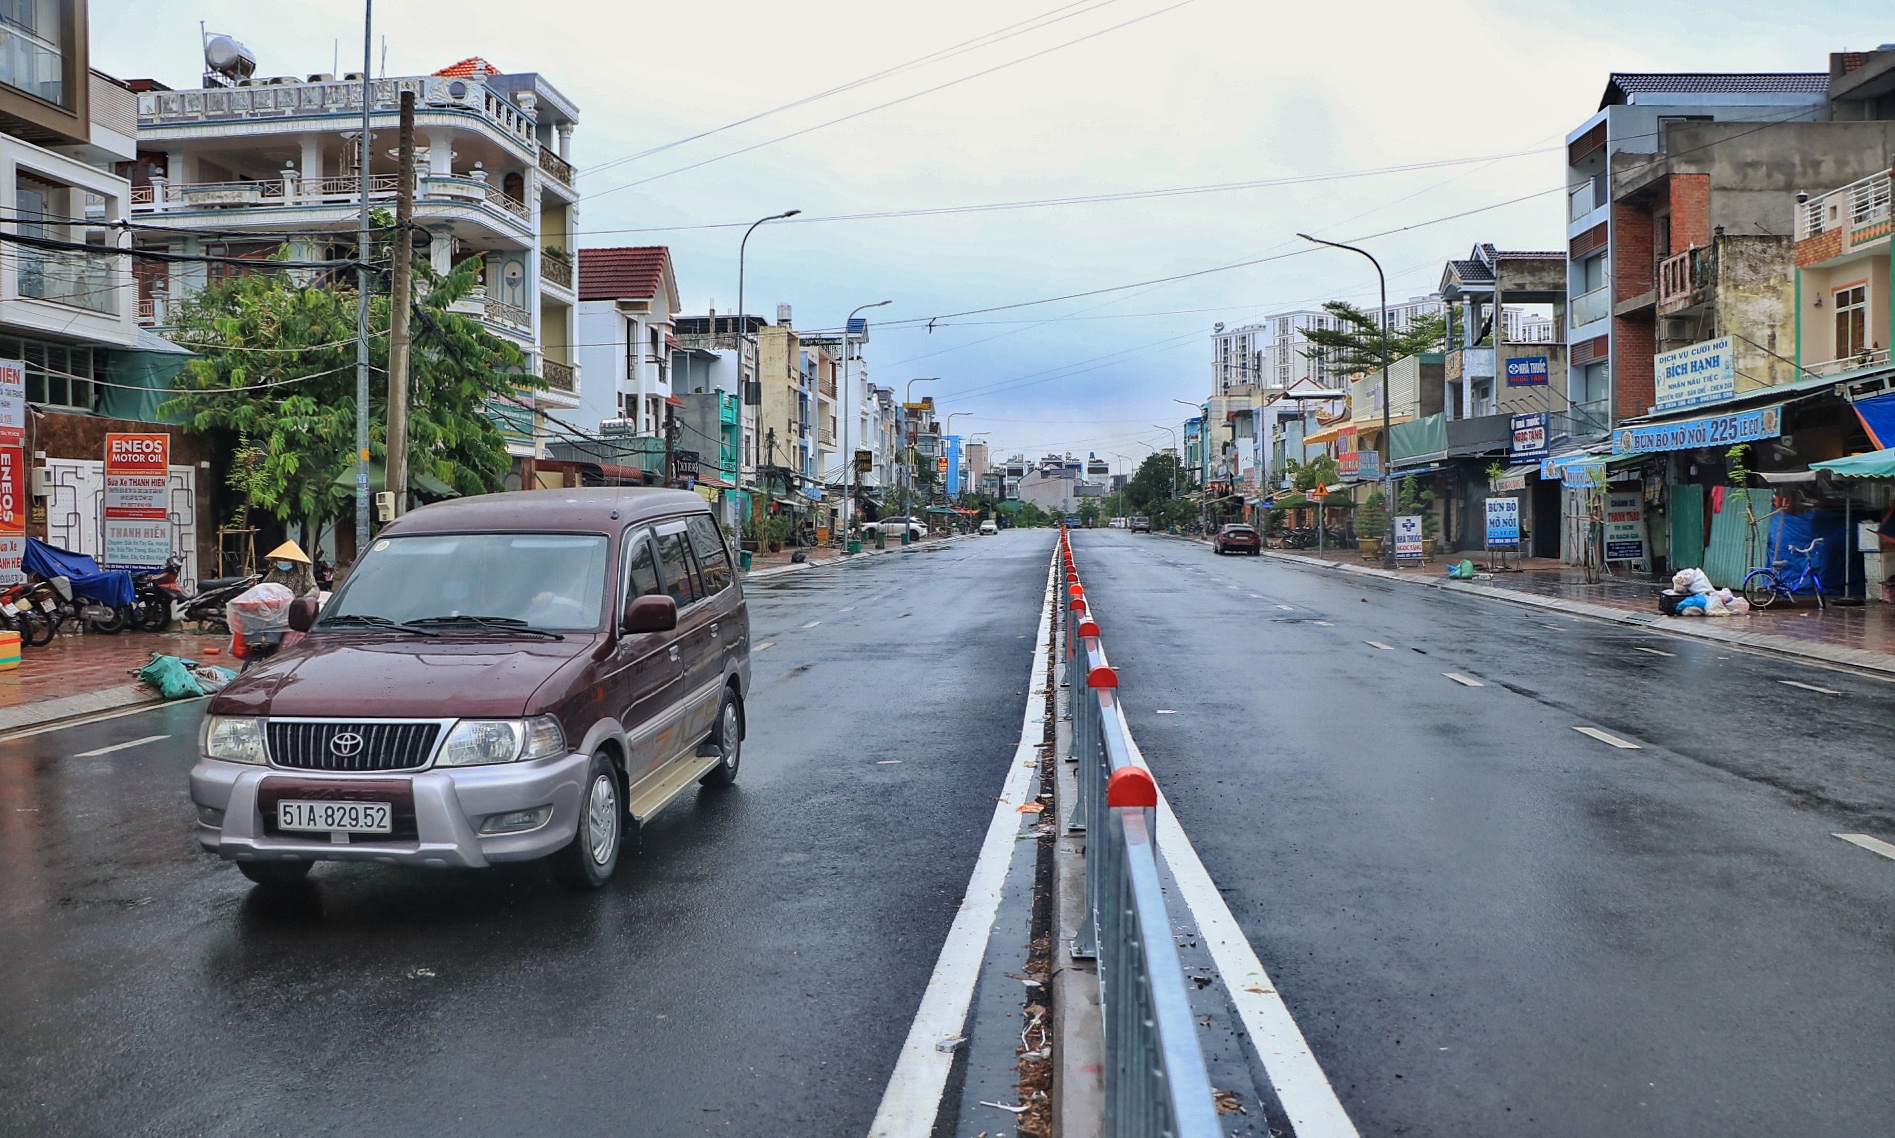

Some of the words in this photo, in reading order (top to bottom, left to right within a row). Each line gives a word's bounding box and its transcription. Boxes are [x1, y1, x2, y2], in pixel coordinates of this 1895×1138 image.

[1659, 354, 1676, 364] DỊCH
[1678, 350, 1688, 358] VỤ
[1666, 362, 1688, 378] BÍCH
[1690, 355, 1720, 374] HẠNH
[1634, 431, 1654, 449] BÚN
[1656, 428, 1669, 447] BÒ
[1710, 417, 1738, 442] 225
[112, 440, 162, 453] ENEOS
[112, 454, 146, 462] MOTOR
[148, 454, 162, 463] OIL
[0, 454, 14, 522] ENEOS
[1488, 501, 1504, 512] BÚN
[1506, 500, 1516, 511] BÒ
[110, 528, 141, 538] THANH
[10, 540, 17, 551] Xe
[283, 804, 387, 828] 51A-829.52
